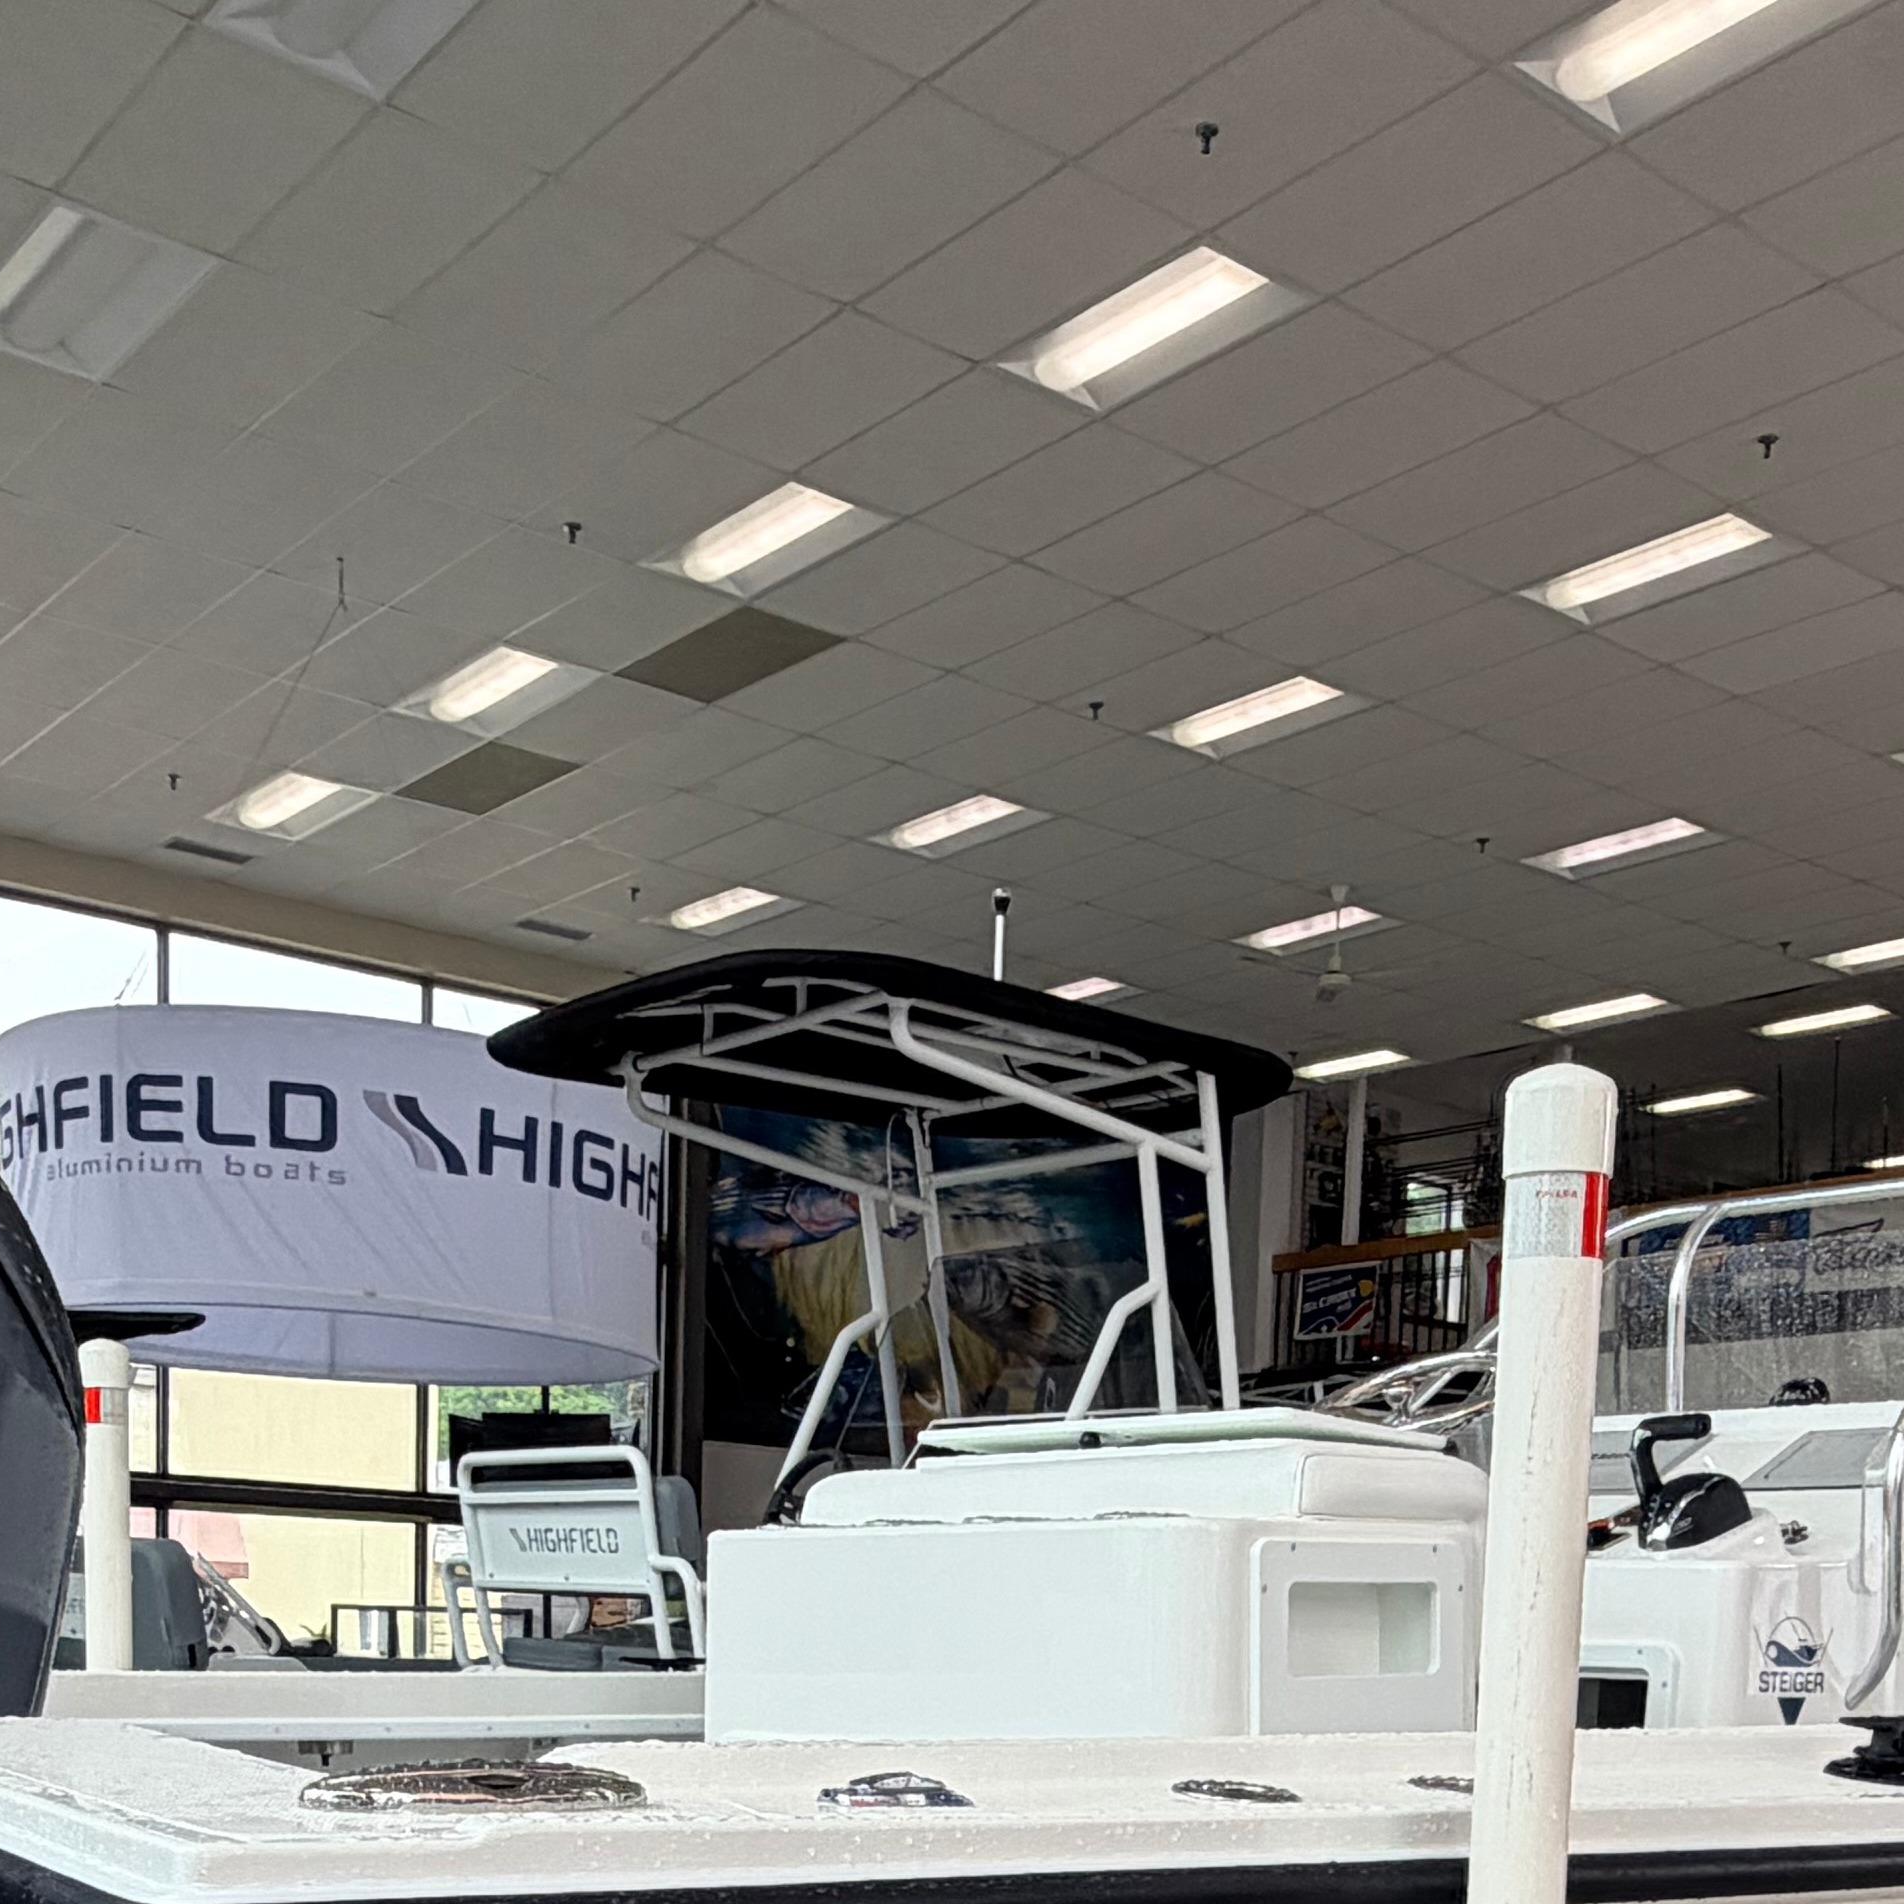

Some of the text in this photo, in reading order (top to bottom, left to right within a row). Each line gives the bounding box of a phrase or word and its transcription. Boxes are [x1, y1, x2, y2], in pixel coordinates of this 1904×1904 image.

[47, 1152, 347, 1186] aluminium boats
[526, 1527, 619, 1554] HIGHFIELD
[1758, 1671, 1825, 1693] STEIGER
